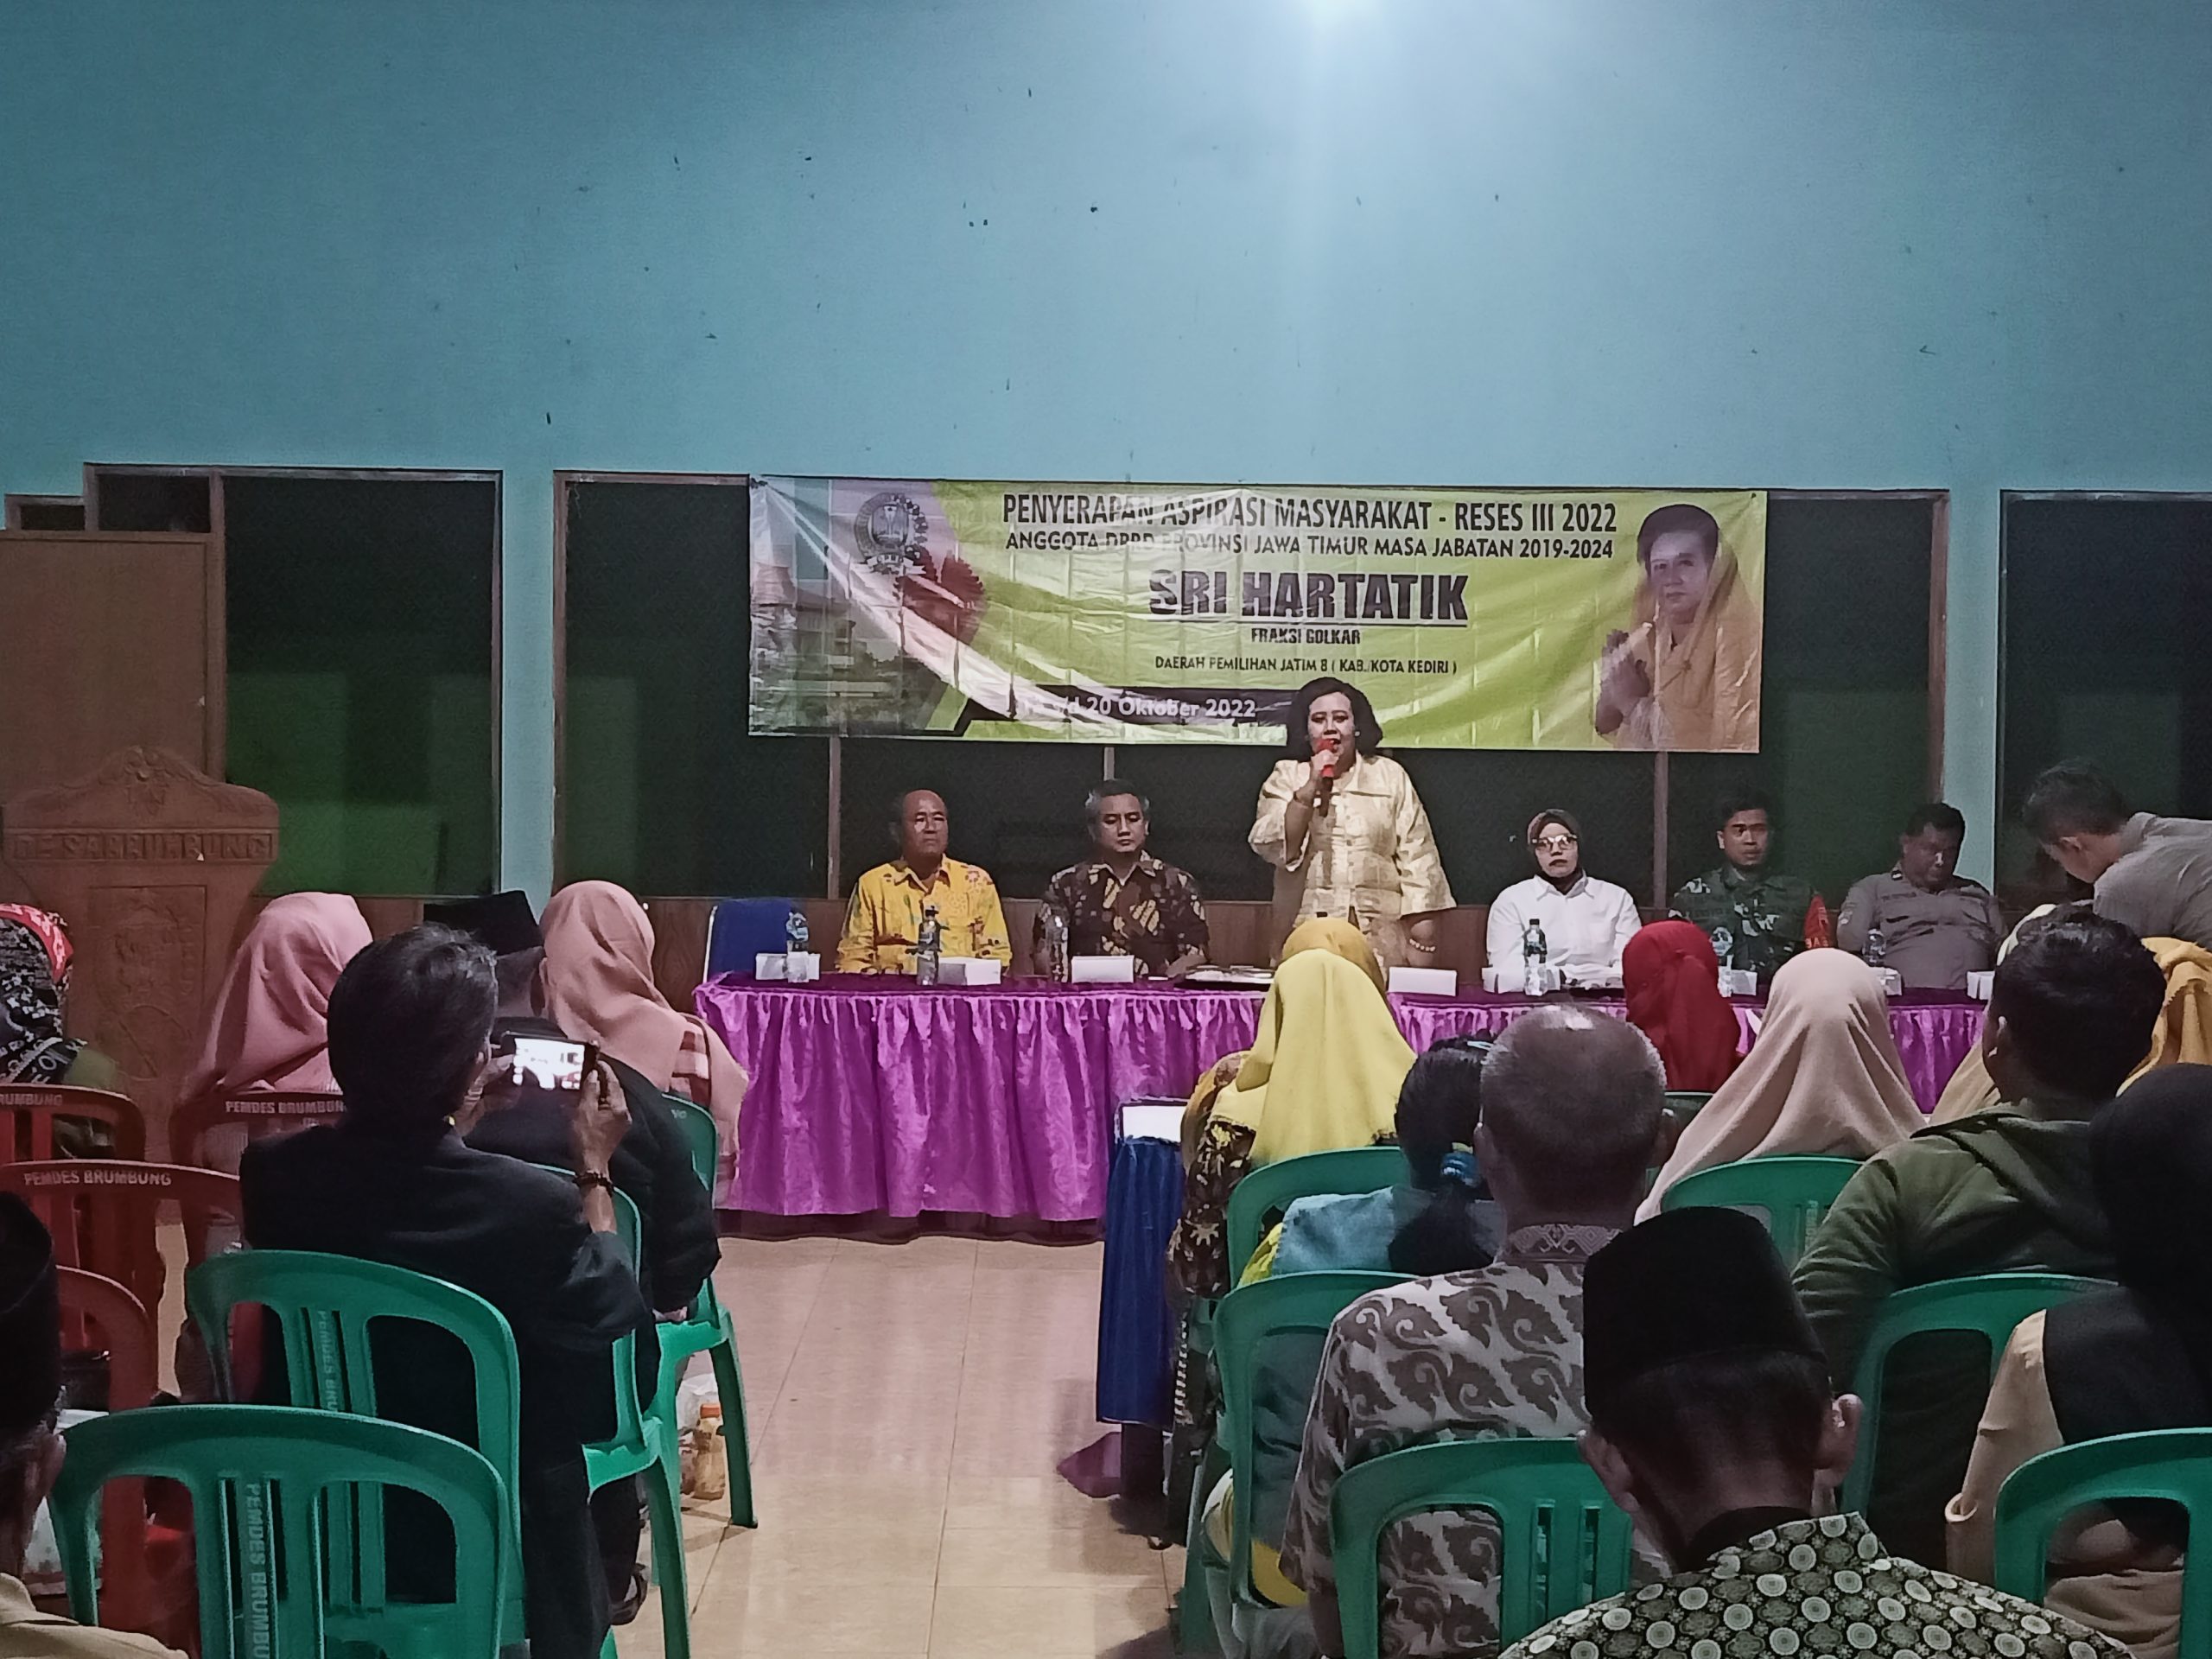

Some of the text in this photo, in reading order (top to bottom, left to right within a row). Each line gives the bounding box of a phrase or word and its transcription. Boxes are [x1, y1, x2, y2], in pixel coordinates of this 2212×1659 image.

[1003, 493, 1154, 525] PENYERAPAN
[1160, 497, 1268, 528] ASPIRASI
[1275, 499, 1433, 531] MASYARAKAT
[1454, 503, 1522, 531] RESES
[1531, 503, 1554, 531] III
[1562, 504, 1618, 532] 2022
[1006, 531, 1099, 550] ANGGOTA
[1255, 536, 1300, 555] JAWA
[1308, 537, 1368, 556] TIMUR
[1375, 538, 1426, 556] MASA
[1432, 539, 1514, 558] JABATAN
[1519, 539, 1613, 559] 2019-2024
[1150, 569, 1469, 620] SRI HARTATIK
[1251, 628, 1361, 645] FRAKSI GOLKAR
[1155, 657, 1205, 670] DAERAH
[1209, 657, 1276, 671] PEMILIHAN
[1281, 658, 1317, 671] JATIM
[1408, 660, 1449, 674] KEDIRI
[1087, 696, 1111, 715] 20
[1118, 697, 1198, 717] Oktober
[1205, 698, 1255, 718] 2022
[84, 1171, 172, 1185] BRUMBUNG
[246, 1484, 265, 1565] PEMDES
